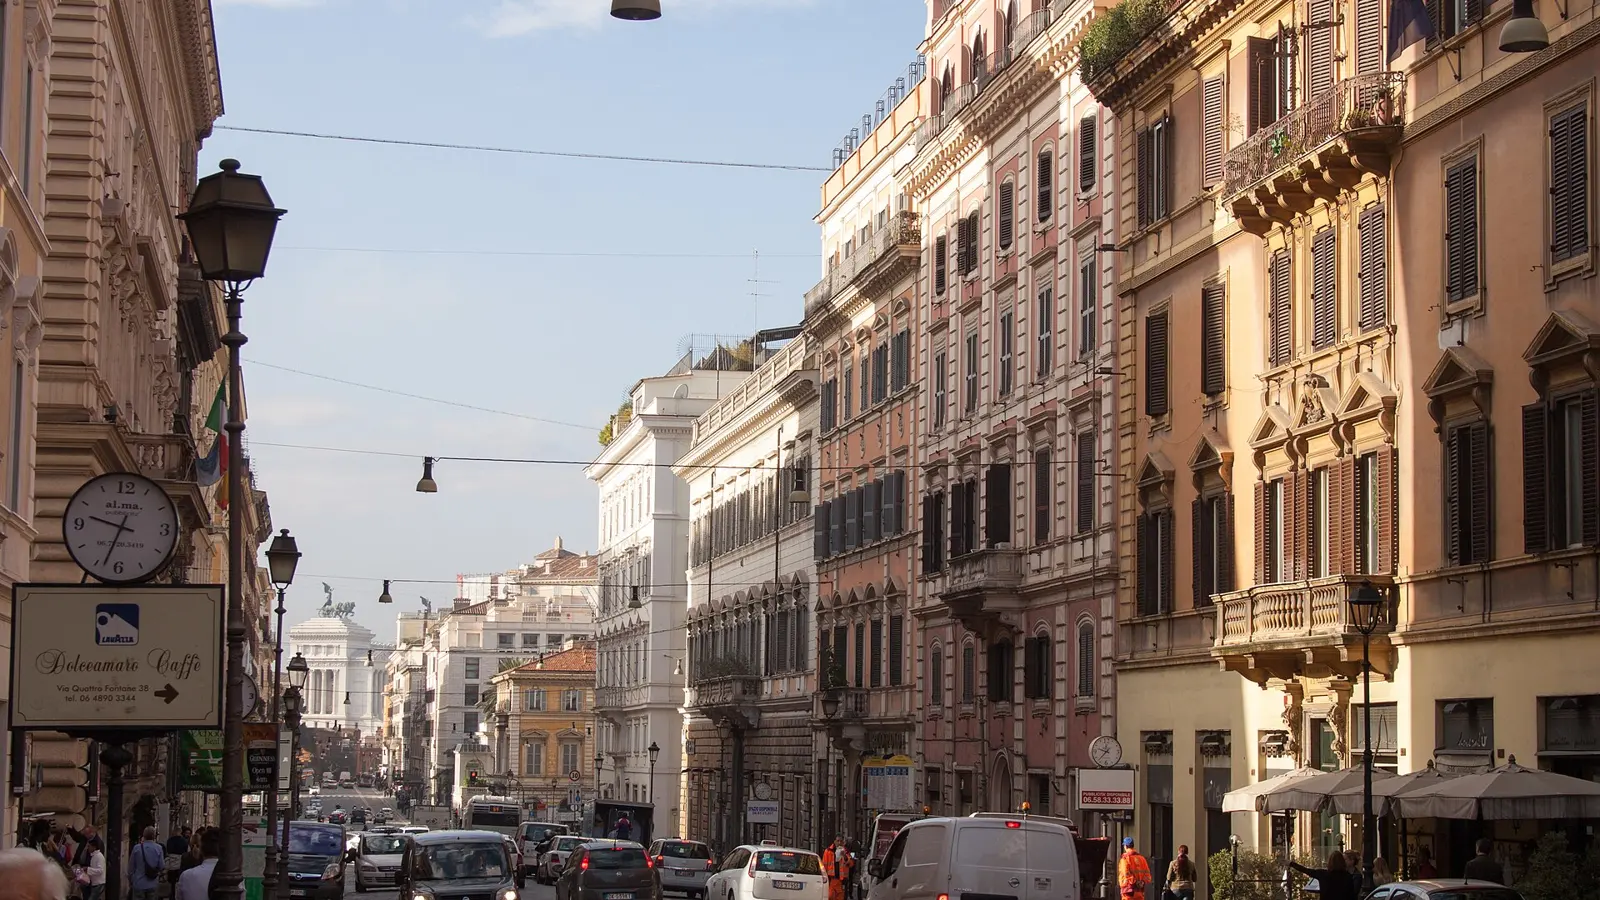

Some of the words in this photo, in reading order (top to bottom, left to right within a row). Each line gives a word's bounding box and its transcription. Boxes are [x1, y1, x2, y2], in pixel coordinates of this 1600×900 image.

[117, 481, 136, 494] 12
[74, 517, 85, 531] 9
[159, 523, 170, 536] 3
[113, 561, 124, 574] 6
[102, 634, 134, 643] LAVAZZA
[35, 648, 139, 675] Dolceamaro
[57, 685, 70, 693] Via
[72, 684, 103, 693] Quattro
[105, 685, 137, 693] Fontane
[138, 685, 149, 693] 38
[251, 767, 266, 775] Open
